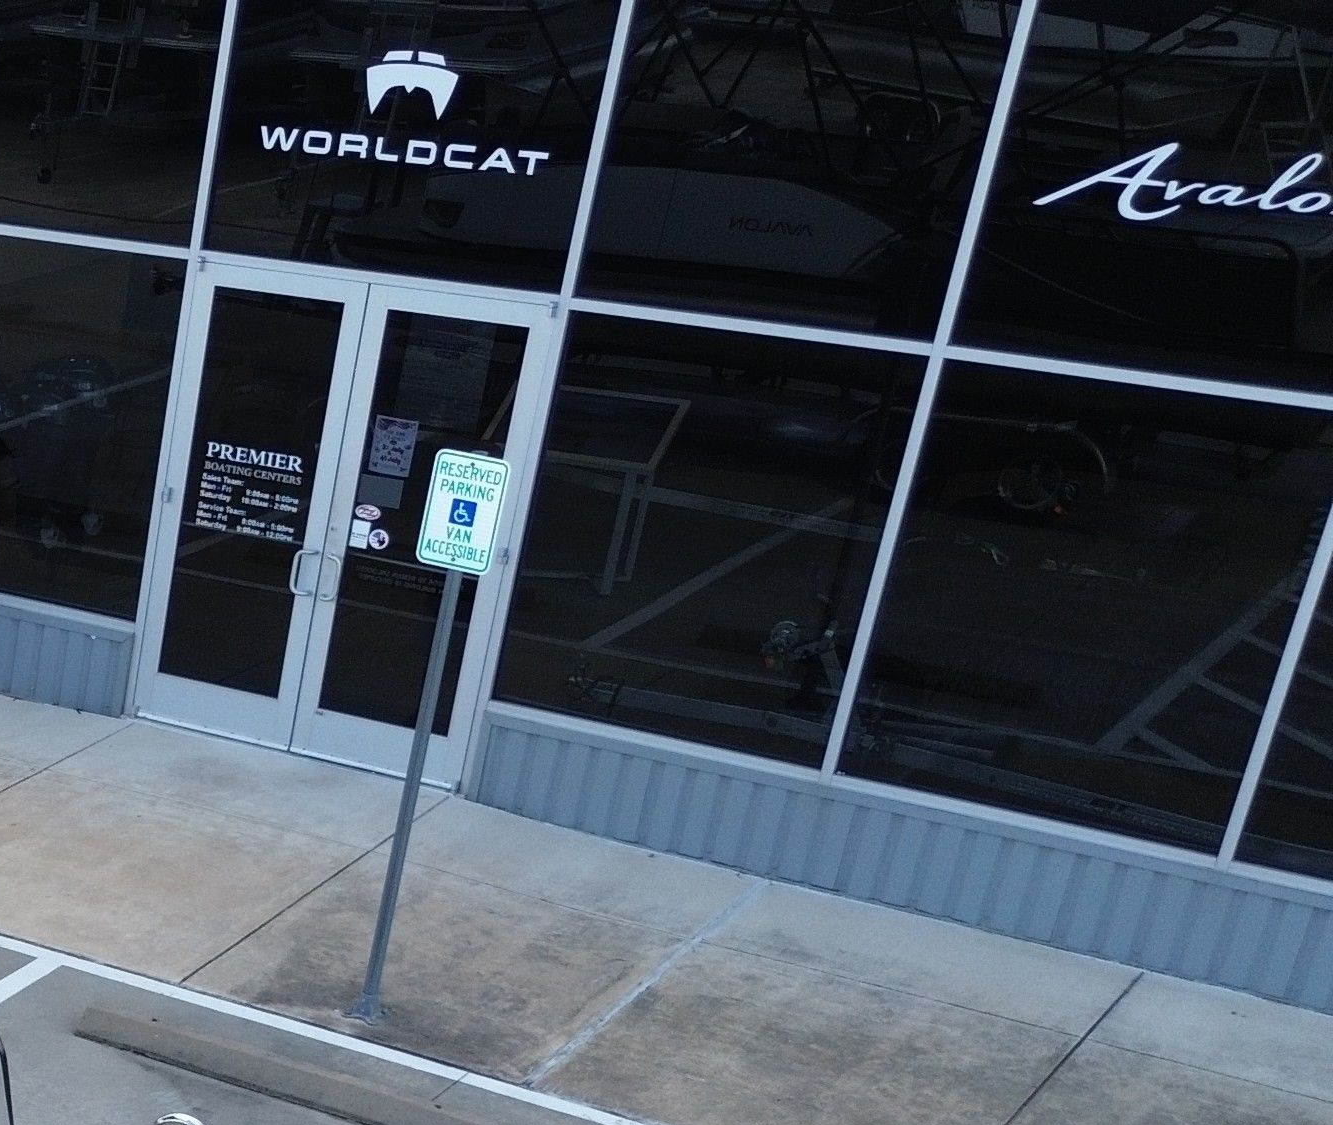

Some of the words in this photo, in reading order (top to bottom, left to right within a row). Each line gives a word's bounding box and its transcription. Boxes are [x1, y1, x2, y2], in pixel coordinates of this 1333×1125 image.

[261, 125, 549, 175] WORLDCAT
[1033, 143, 1333, 221] Avalo
[205, 441, 303, 473] PREMIER
[204, 461, 252, 478] BOATING
[253, 469, 302, 486] CENTERS
[439, 461, 502, 485] RESERVED
[199, 489, 232, 503] Saturday
[440, 479, 495, 501] PARKING
[446, 525, 472, 543] VAN
[424, 538, 486, 563] ACCESSIBLE
